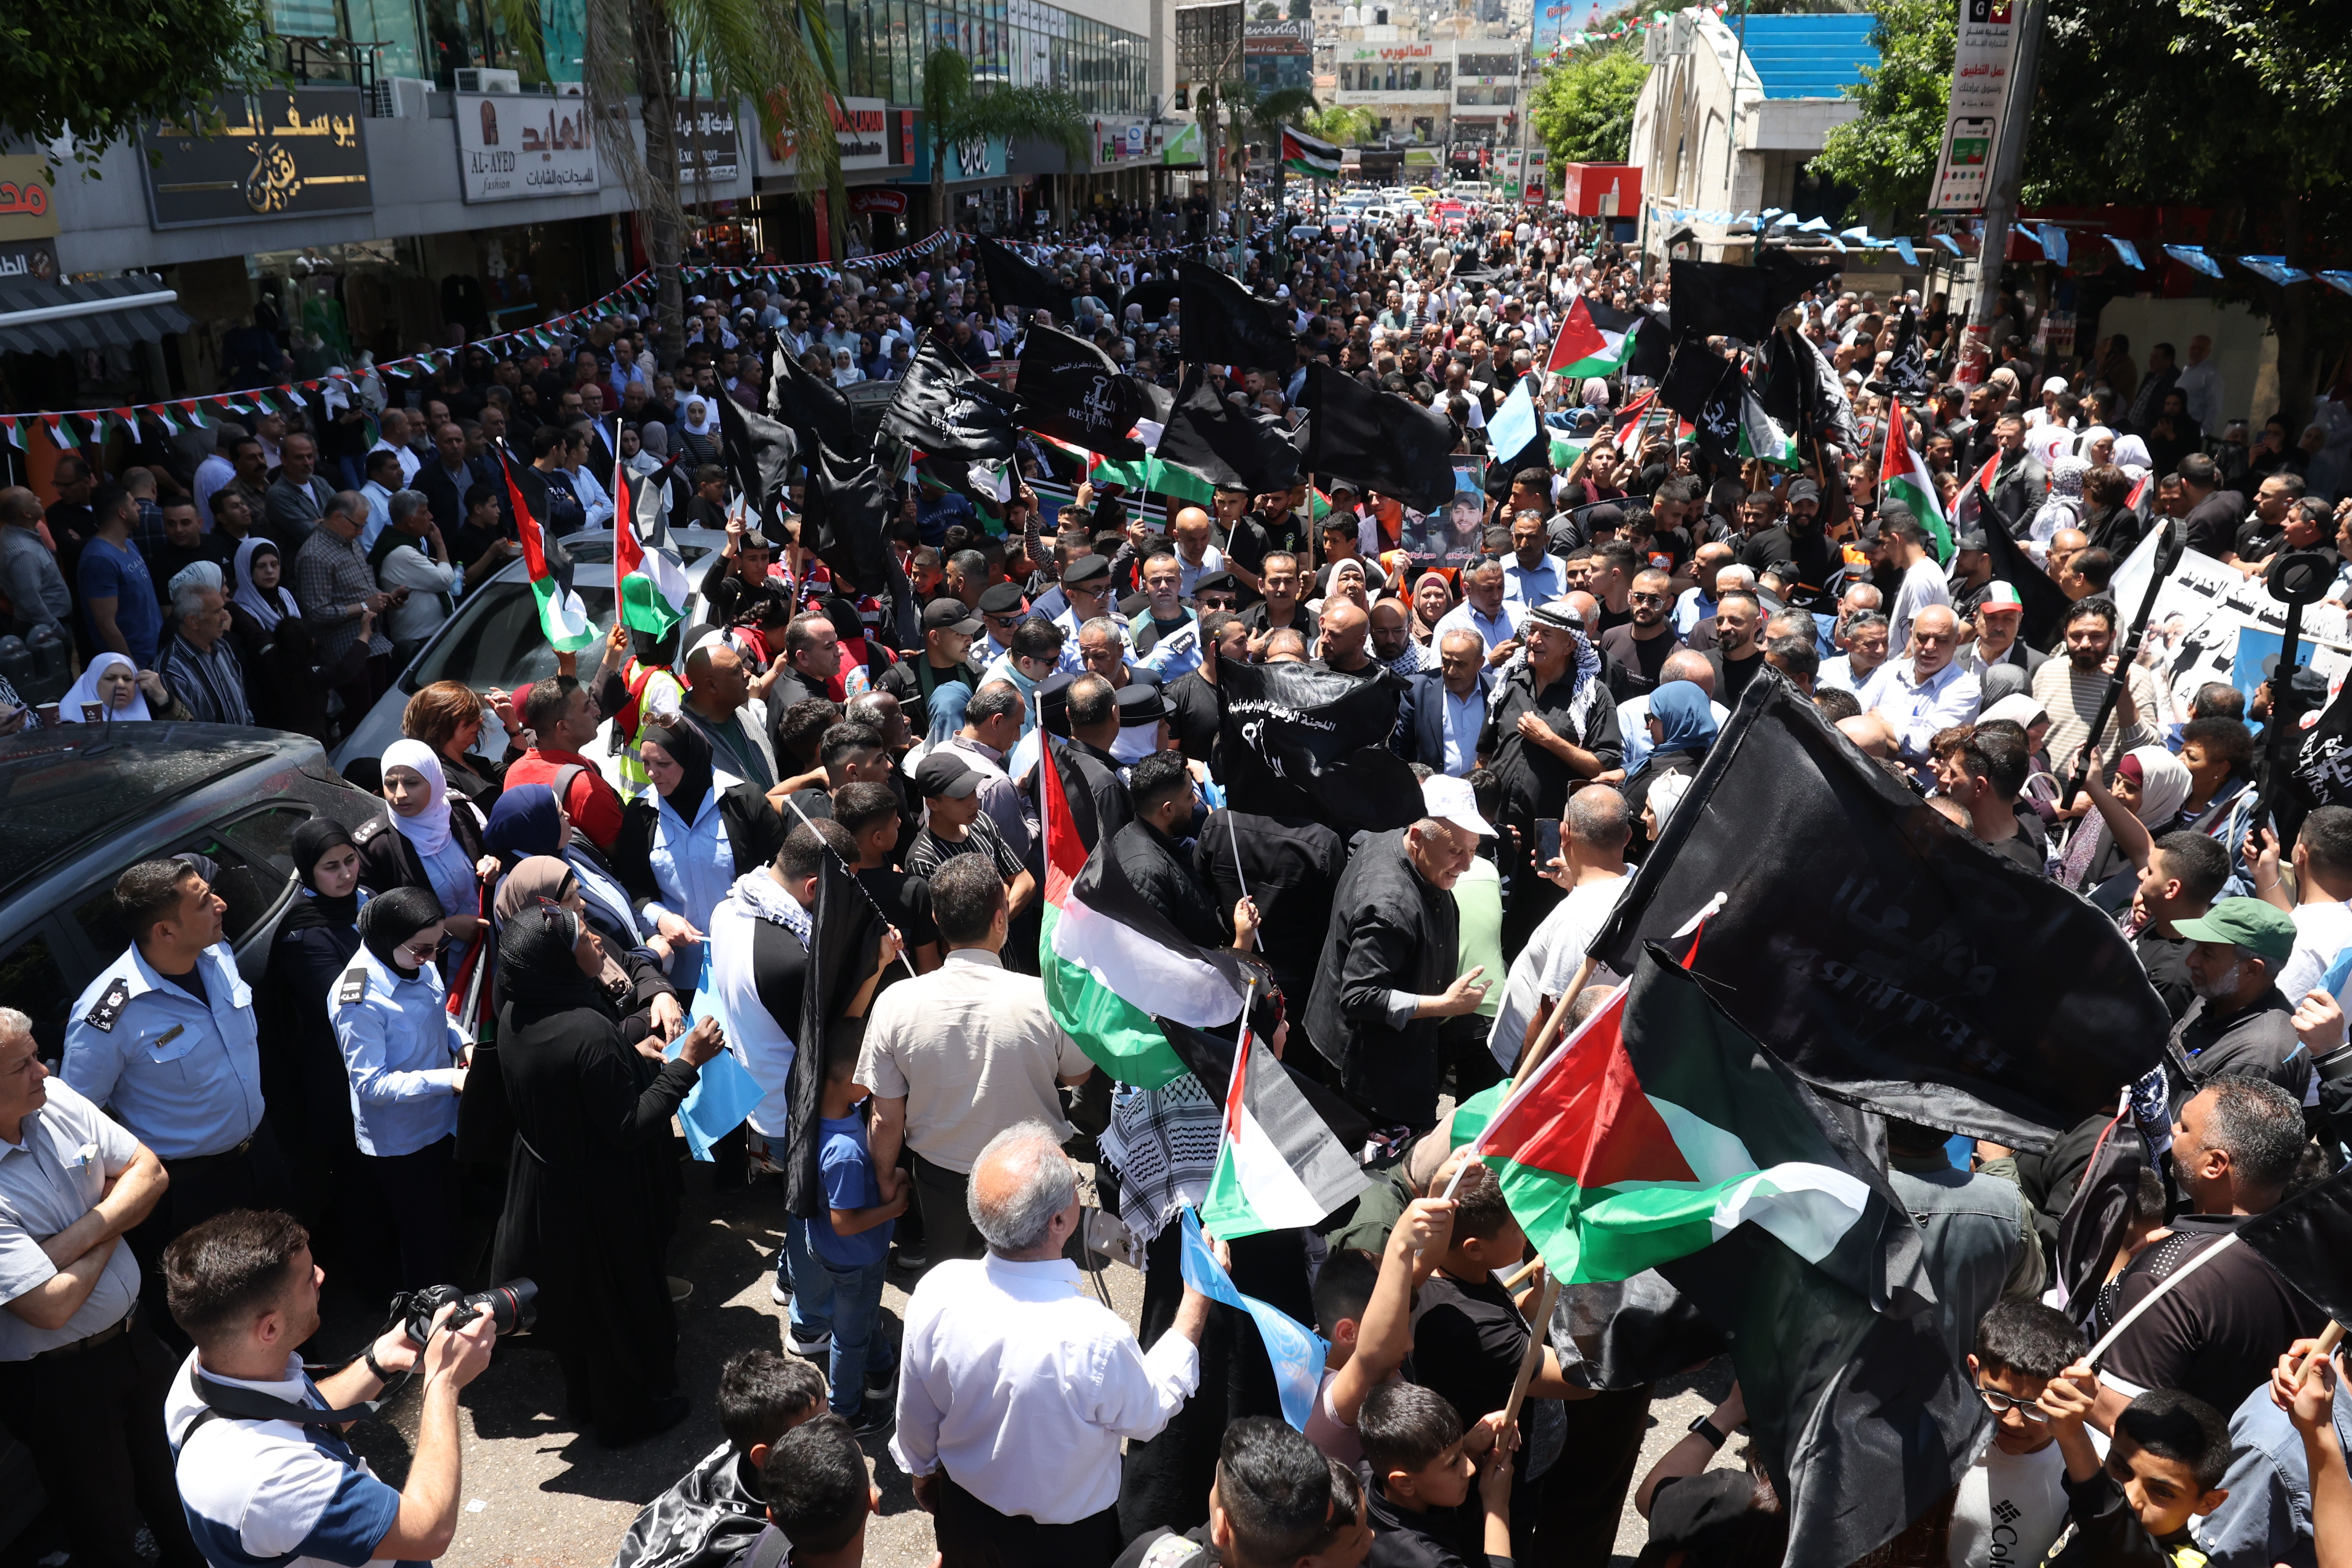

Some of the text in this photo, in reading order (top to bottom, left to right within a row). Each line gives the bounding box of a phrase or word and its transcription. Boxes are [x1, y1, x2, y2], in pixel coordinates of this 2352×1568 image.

[1547, 5, 1572, 18] Bingo
[1244, 19, 1299, 35] evanta
[1960, 63, 2005, 78] حمل التطبيق
[270, 95, 356, 147] يوسف
[522, 108, 590, 161] العايد
[678, 148, 718, 165] Excnger
[482, 177, 510, 194] fashion
[526, 168, 594, 189] للسيدات والشابات
[1051, 362, 1072, 374] النكبة
[1072, 361, 1091, 369] ذكرى
[1083, 391, 1116, 413] العودة
[931, 416, 968, 437] RETURN
[1067, 407, 1113, 429] RETURN
[930, 510, 943, 519] POLO
[2177, 570, 2229, 601] الجديد
[2217, 588, 2258, 616] عسكر
[2253, 605, 2287, 630] خيم
[1268, 702, 1301, 723] الوطنية
[1300, 713, 1337, 732] اللجنة
[2298, 729, 2334, 805] RETURN
[86, 1014, 111, 1031] الشرطة
